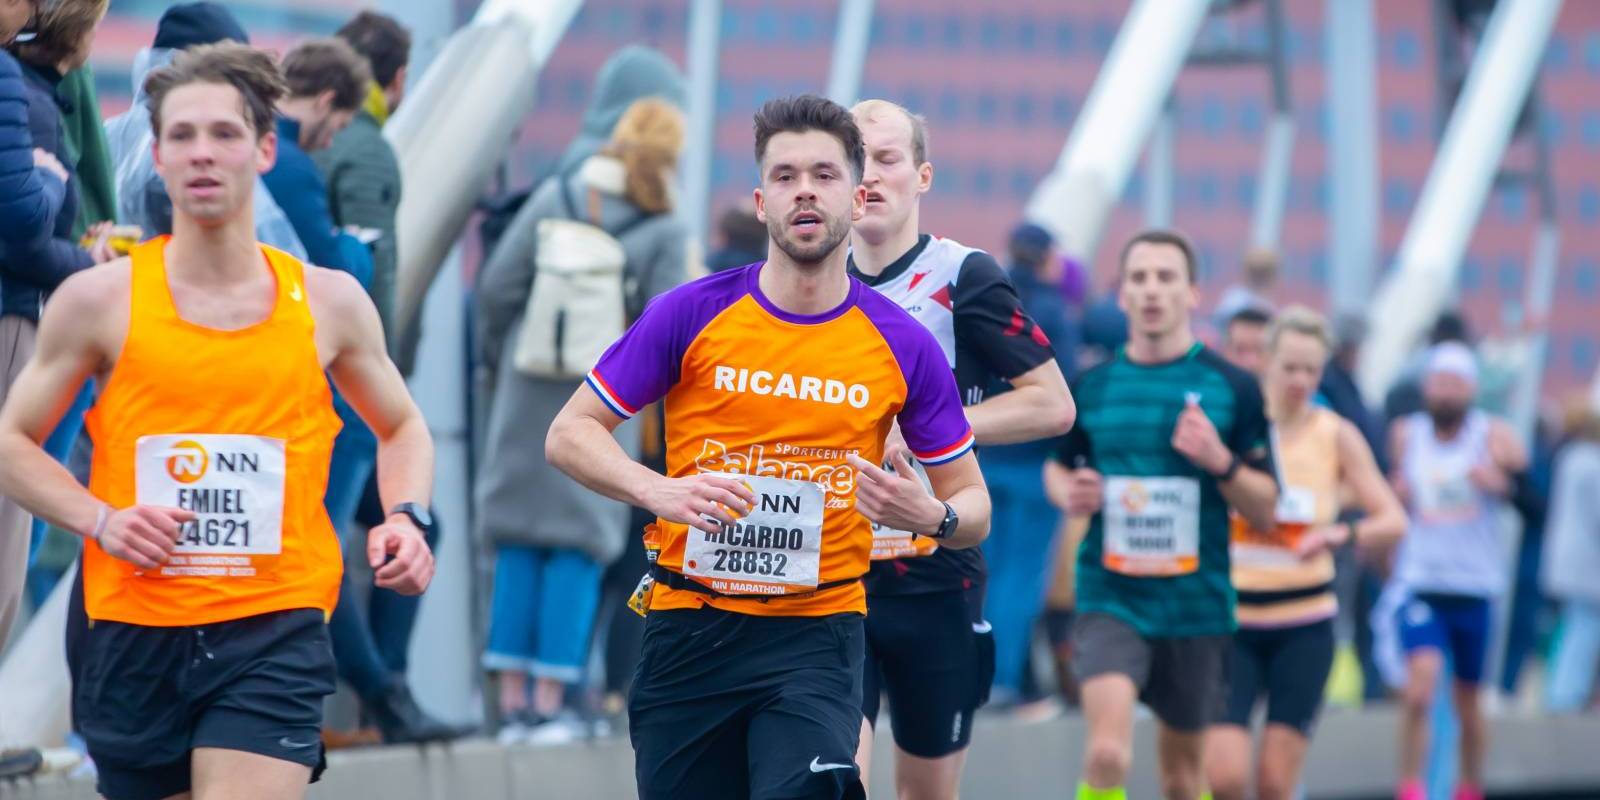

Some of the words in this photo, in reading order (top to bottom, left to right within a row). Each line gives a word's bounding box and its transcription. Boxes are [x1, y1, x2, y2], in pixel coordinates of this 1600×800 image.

[714, 365, 870, 409] RICARDO
[216, 452, 259, 473] NN
[178, 488, 245, 514] EMIEL
[761, 493, 801, 514] NN
[713, 549, 788, 577] 28832
[711, 580, 727, 590] NN
[730, 582, 785, 595] MARATHON
